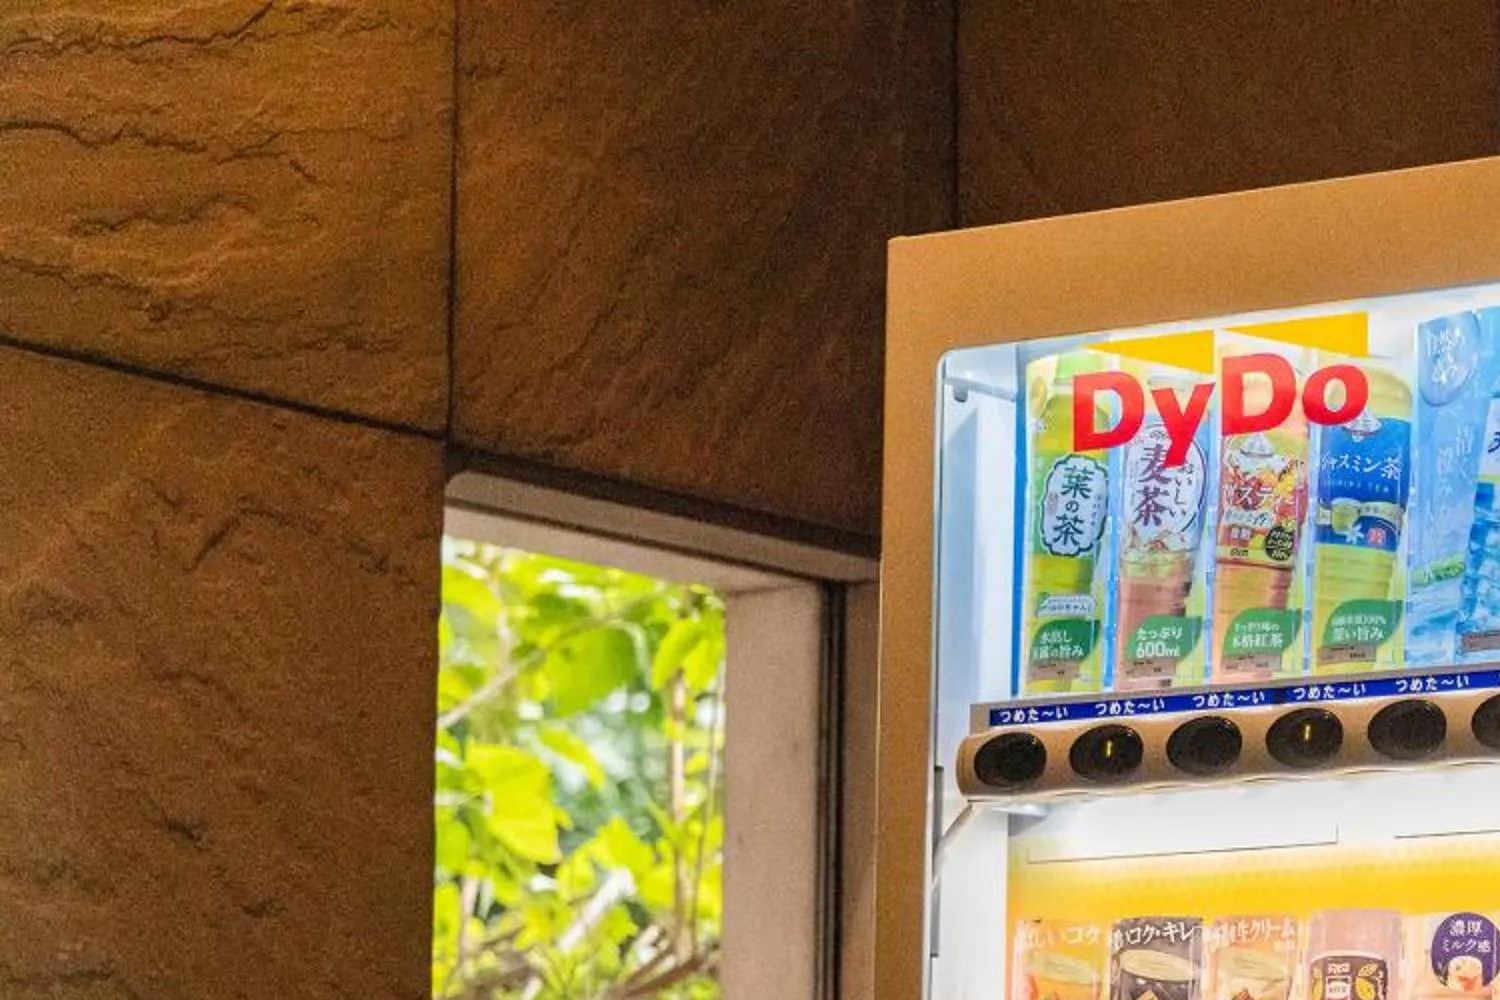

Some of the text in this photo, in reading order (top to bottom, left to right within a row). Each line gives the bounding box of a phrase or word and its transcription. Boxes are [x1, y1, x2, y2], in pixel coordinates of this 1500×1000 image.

[1073, 353, 1369, 469] DyDo
[1052, 465, 1095, 547] 葉の茶
[1134, 444, 1172, 527] 麦茶
[1136, 626, 1183, 642] たっぷり
[1441, 938, 1491, 954] ミルク感
[1449, 918, 1483, 936] 濃厚
